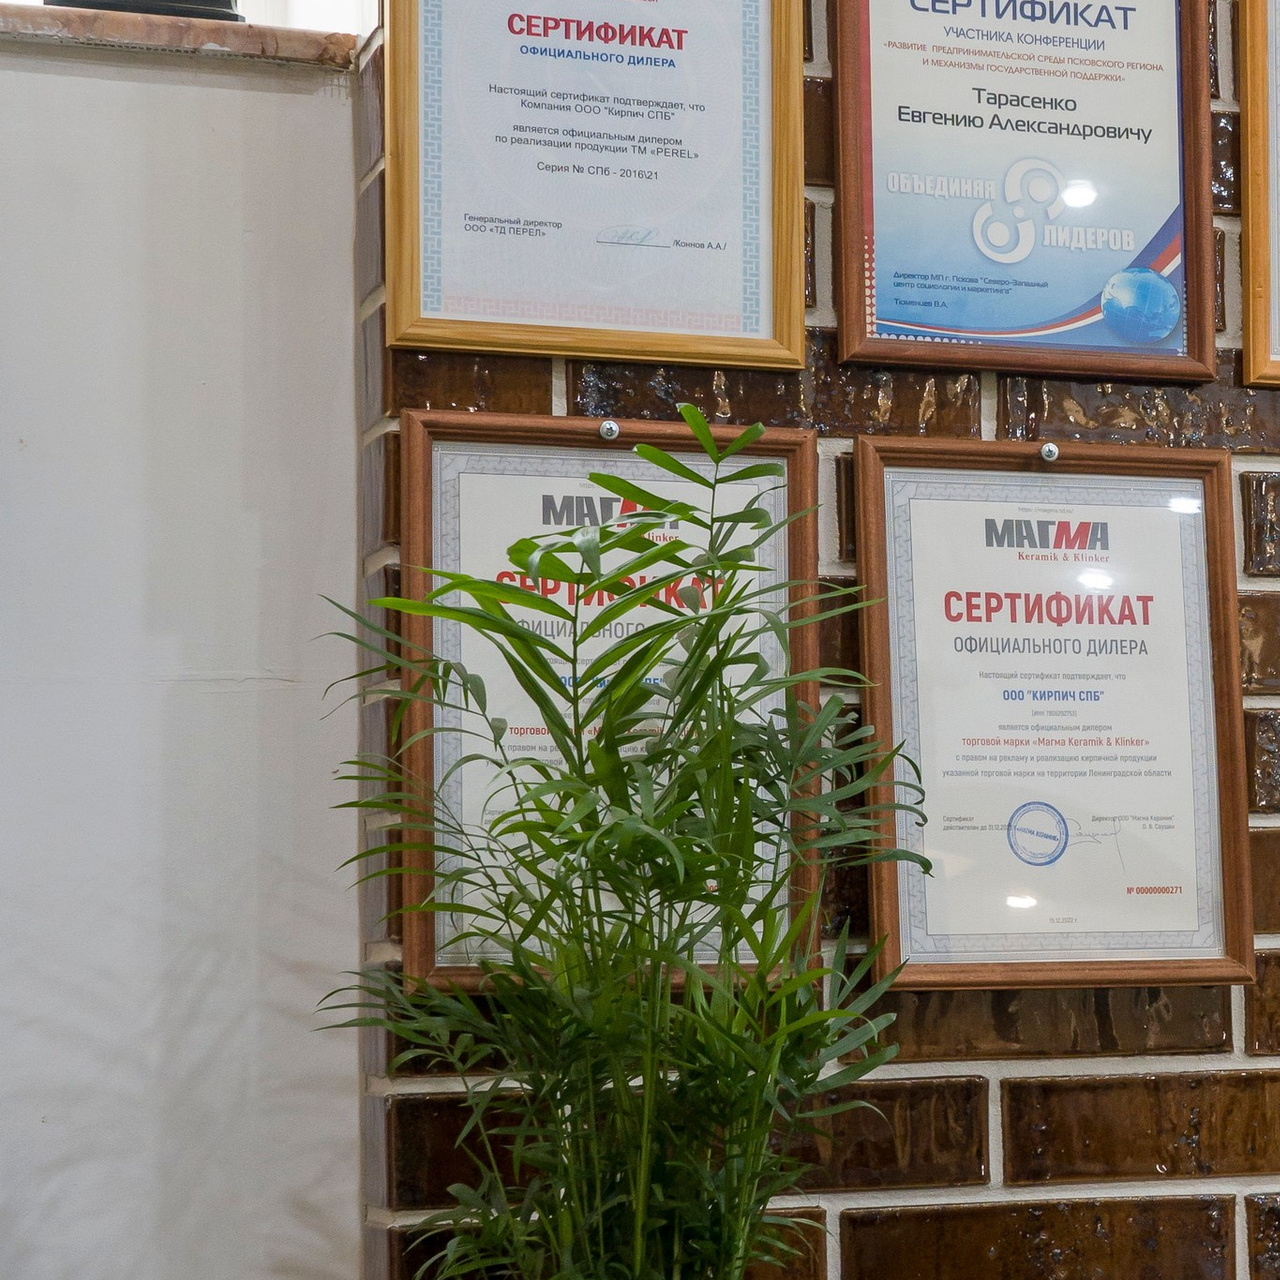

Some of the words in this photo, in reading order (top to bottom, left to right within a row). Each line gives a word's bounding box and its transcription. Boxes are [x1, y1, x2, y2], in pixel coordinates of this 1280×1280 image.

[507, 13, 688, 50] СЕРТИФИКАТ
[943, 26, 1014, 43] УЧАСТНИКА
[1017, 33, 1105, 51] КОНФЕРЕНЦИИ
[520, 45, 624, 64] ОФИЦИАЛЬНОГО
[627, 55, 676, 68] ДИЛЕРА
[883, 40, 927, 52] «РАЗВИТИЕ
[932, 45, 1035, 61] ПРЕДПРИНИМАТЕЛЬСКОЙ
[1036, 54, 1066, 65] СРЕДЫ
[1066, 56, 1125, 70] ПСКОВСКОГО
[1126, 61, 1165, 72] РЕГИОНА
[489, 84, 547, 98] Настоящий
[550, 91, 611, 104] сертификат
[613, 97, 685, 111] подтверждает,
[688, 103, 706, 112] что
[521, 99, 571, 112] Компания
[574, 103, 602, 115] ООО
[603, 106, 645, 119] "Кирпич
[647, 109, 676, 121] СПБ"
[972, 87, 1077, 111] Тарасенко
[898, 105, 984, 128] Евгению
[988, 114, 1152, 144] Александровичу
[537, 161, 570, 174] Серия
[572, 163, 585, 174] №
[587, 165, 611, 177] СПб
[619, 167, 658, 181] 2016\21
[542, 494, 679, 530] МАГ
[985, 518, 1109, 551] МАГМА
[1017, 551, 1059, 562] Keramik
[1073, 552, 1110, 563] Klinker
[944, 591, 1154, 627] СЕРТИФИКАТ
[954, 635, 1081, 655] ОФИЦИАЛЬНОГО
[1086, 639, 1148, 657] ДИЛЕРА
[1002, 689, 1025, 701] ООО
[1026, 689, 1076, 702] "КИРПИЧ
[1078, 690, 1105, 702] СПБ"
[961, 735, 1002, 748] торговой
[1002, 738, 1031, 748] марки
[1032, 736, 1067, 747] «Магма
[1067, 736, 1104, 747] Keramik
[1114, 736, 1150, 747] Klinker»
[1126, 886, 1135, 895] №
[1135, 885, 1183, 895] 00000000271
